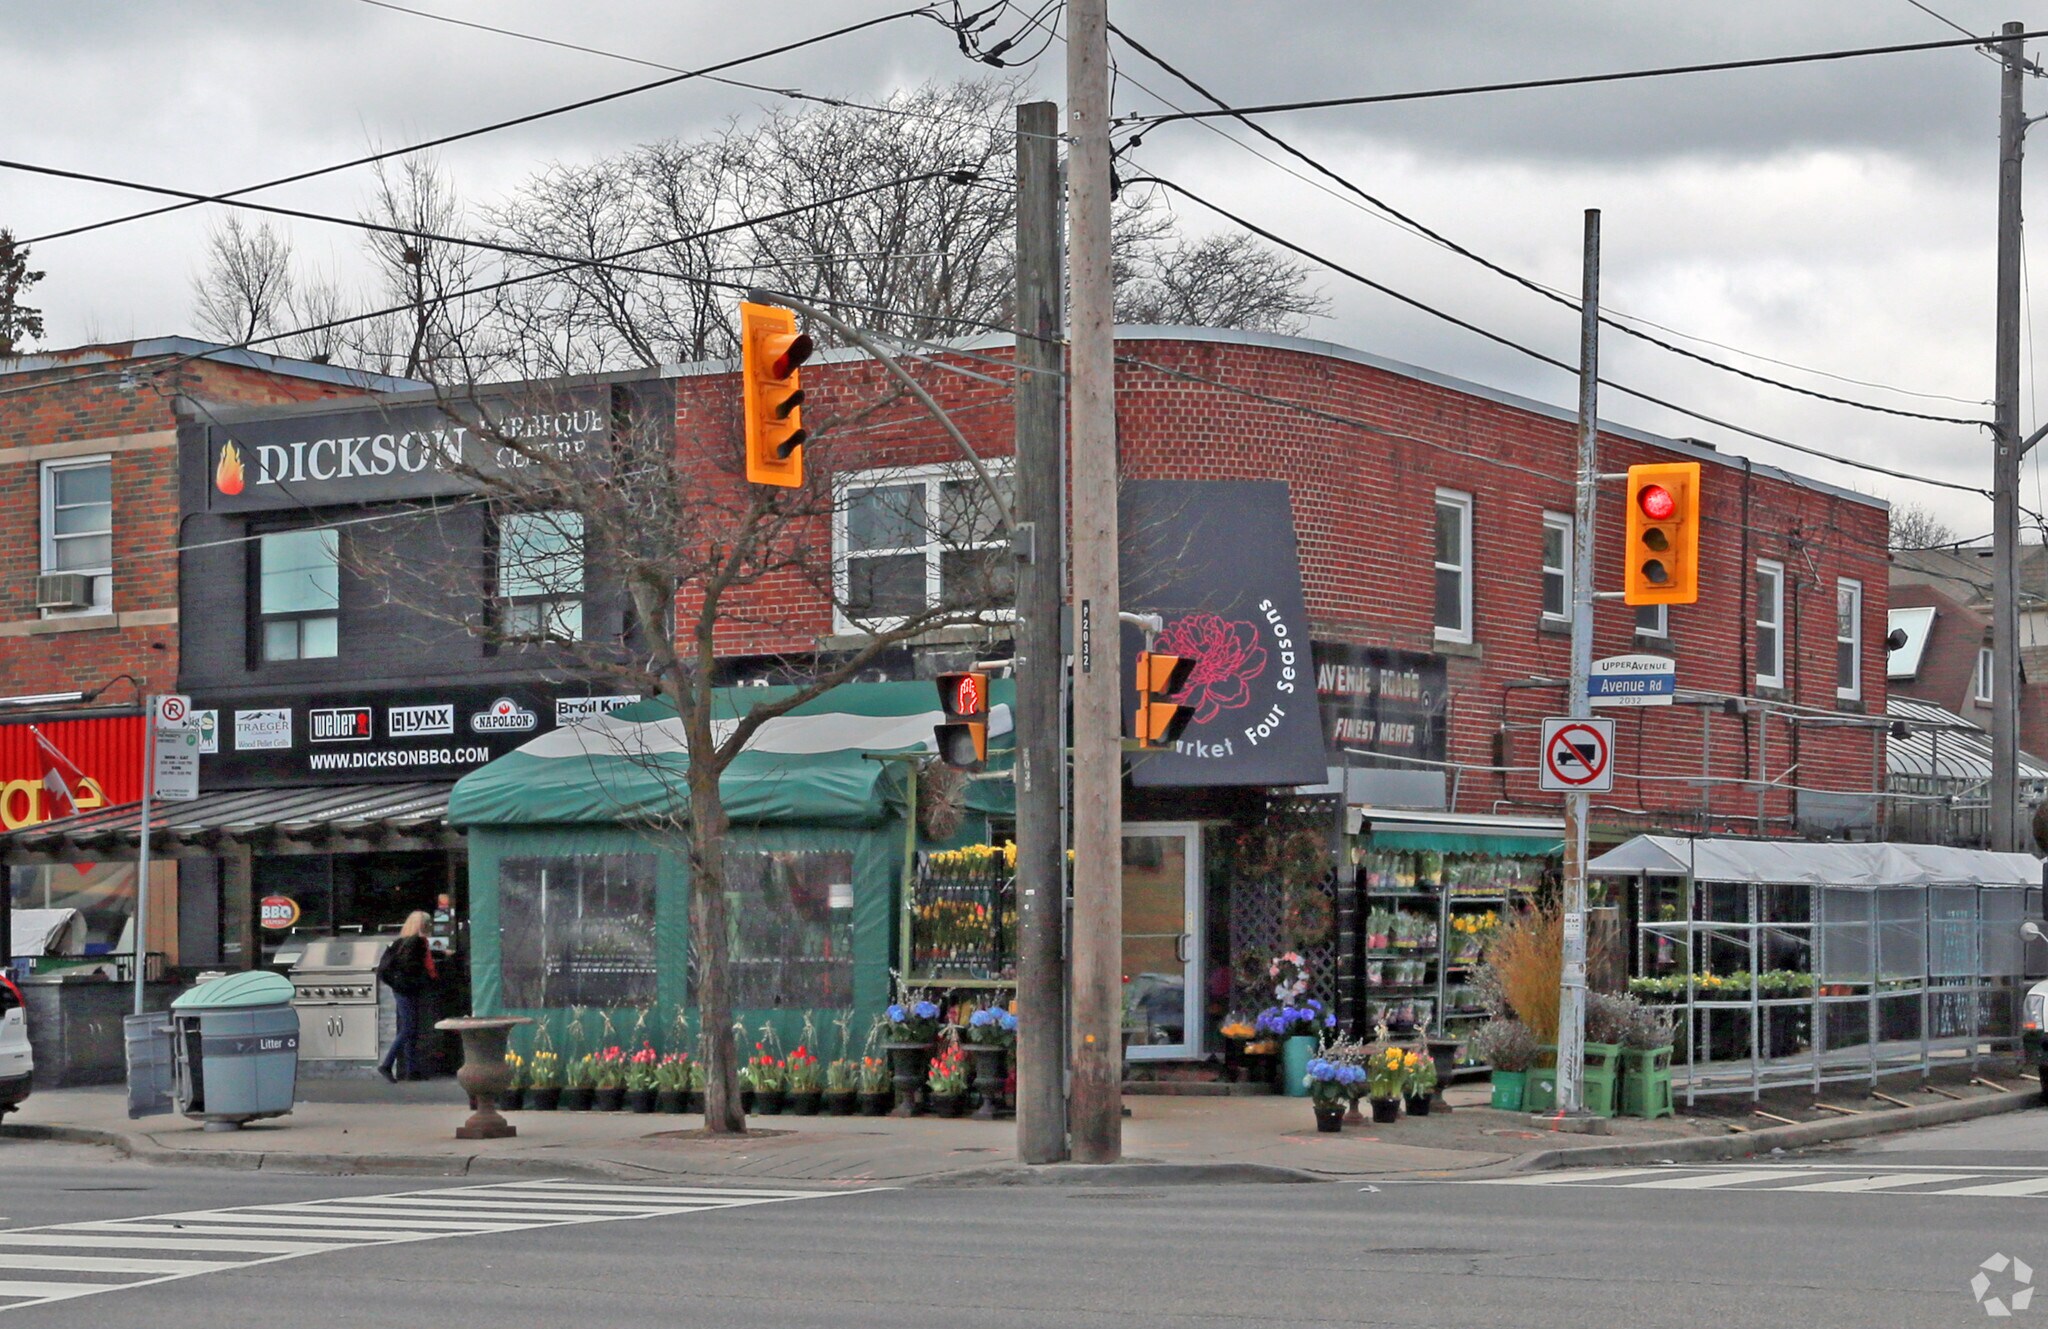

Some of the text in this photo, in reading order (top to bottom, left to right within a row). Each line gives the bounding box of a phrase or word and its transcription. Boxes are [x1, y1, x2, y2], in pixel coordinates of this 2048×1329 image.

[256, 427, 467, 485] DICKSON
[1082, 605, 1090, 667] P2032
[1245, 599, 1296, 746] Four Seasons
[1317, 663, 1371, 695] AVENUE
[1601, 678, 1662, 693] Avenue Rd
[558, 700, 597, 714] Broil
[1618, 696, 1642, 705] 2032
[237, 721, 289, 732] TRAEGER
[313, 708, 356, 737] weber
[406, 708, 449, 732] LYNX
[479, 714, 530, 728] NAPOLEON
[1334, 718, 1415, 744] FINEST MEATS
[238, 740, 256, 748] Wood
[1176, 738, 1234, 758] arket
[310, 747, 489, 770] WWW.DICKSONBBQ.COM
[261, 905, 292, 919] BBQ
[260, 1038, 282, 1050] Litter
